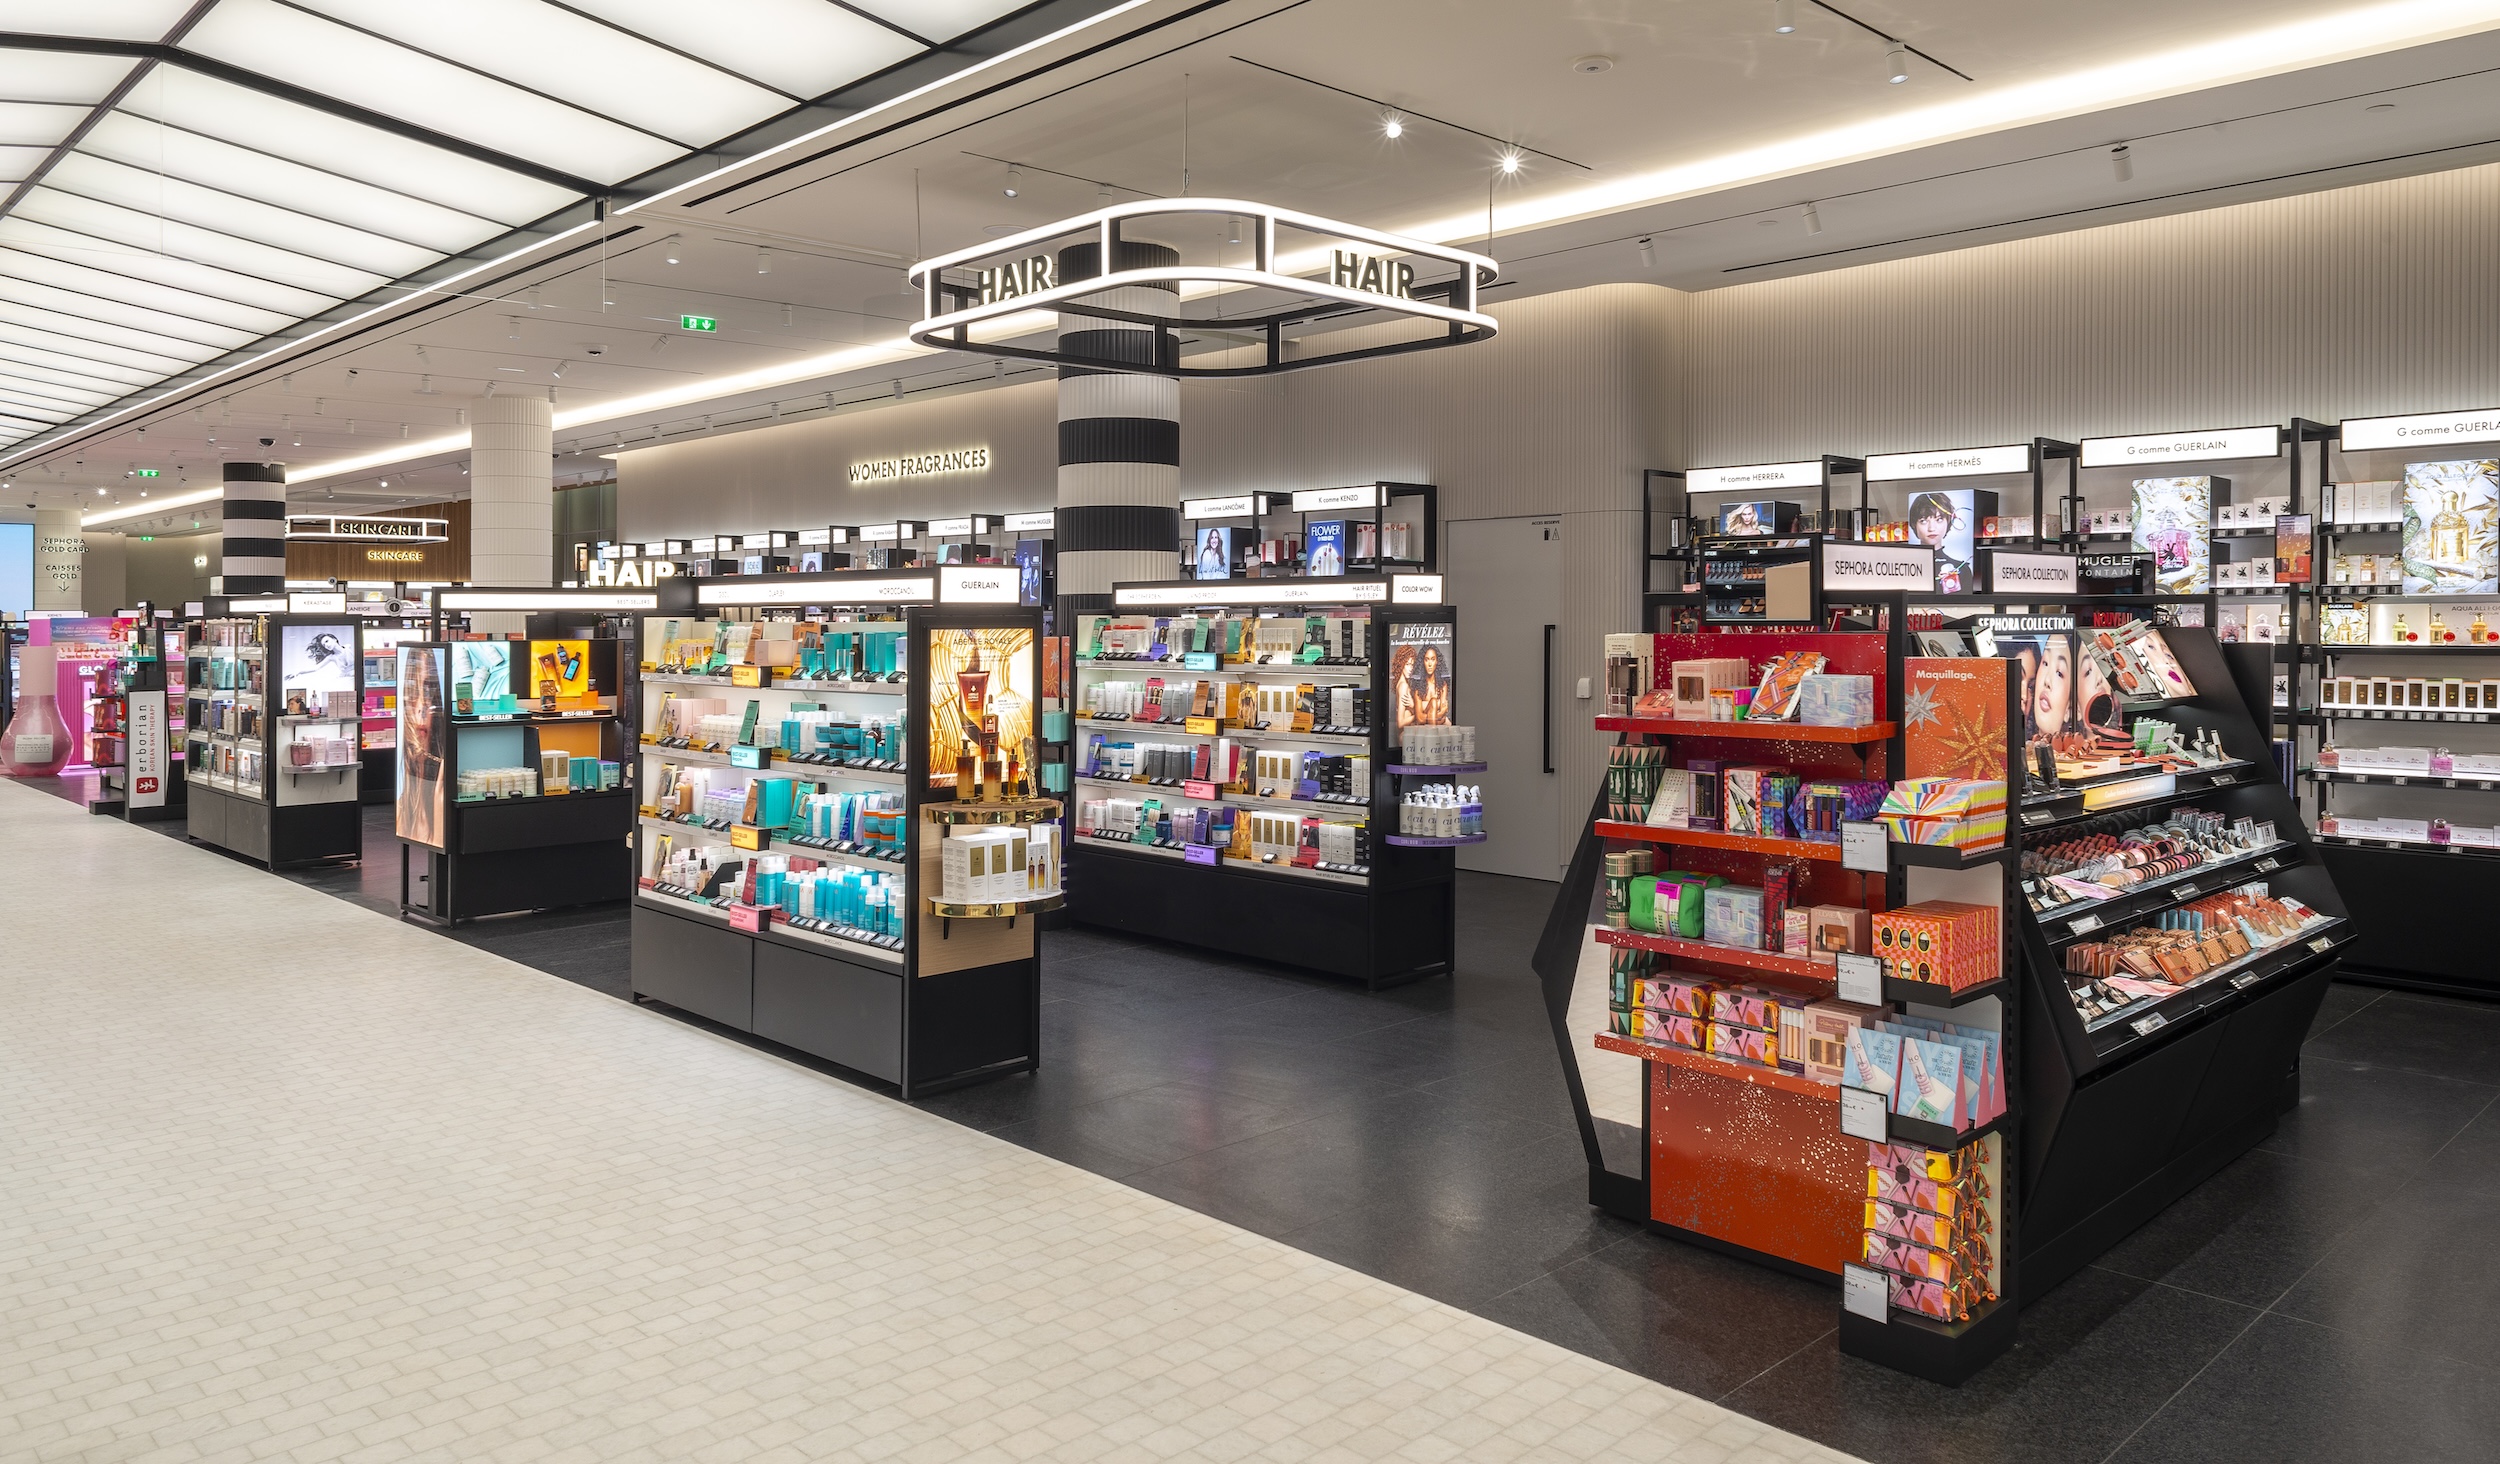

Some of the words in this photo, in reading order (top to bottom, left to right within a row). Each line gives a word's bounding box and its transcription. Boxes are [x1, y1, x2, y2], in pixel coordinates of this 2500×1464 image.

[978, 255, 1053, 306] HAIR
[1329, 249, 1416, 300] HAIR
[2397, 427, 2407, 437] G
[2411, 427, 2450, 436] comme
[2127, 446, 2136, 455] G
[2138, 446, 2171, 454] comme
[2174, 440, 2227, 452] GUERLAIN
[848, 460, 897, 481] WOMEN
[901, 449, 987, 476] FRAGRANCES
[1909, 462, 1915, 470] H
[1917, 462, 1945, 470] comme
[1947, 456, 1982, 468] HERMÈS
[1752, 472, 1785, 481] HERRERA
[1340, 494, 1359, 502] KENZO
[1311, 524, 1341, 537] FLOWER
[367, 550, 423, 562] SKINCARE
[2077, 555, 2141, 567] MUGLER
[1834, 560, 1874, 576] SEPHORA
[1875, 561, 1923, 577] COLLECTION
[2001, 566, 2031, 580] SEPHORA
[2033, 567, 2068, 581] COLLECTION
[2077, 568, 2141, 577] FONTAINE
[961, 581, 999, 589] GUERLAIN
[1907, 613, 1943, 630] SELLER
[1978, 618, 2020, 631] SEPHORA
[2020, 617, 2073, 631] COLLECTION
[1402, 623, 1445, 638] RÉVÉLEZ
[1915, 669, 1977, 683] Maquillage.
[561, 710, 594, 718] BEST-SELLER
[135, 704, 147, 773] erborian
[1918, 1099, 1938, 1117] SEPHORA
